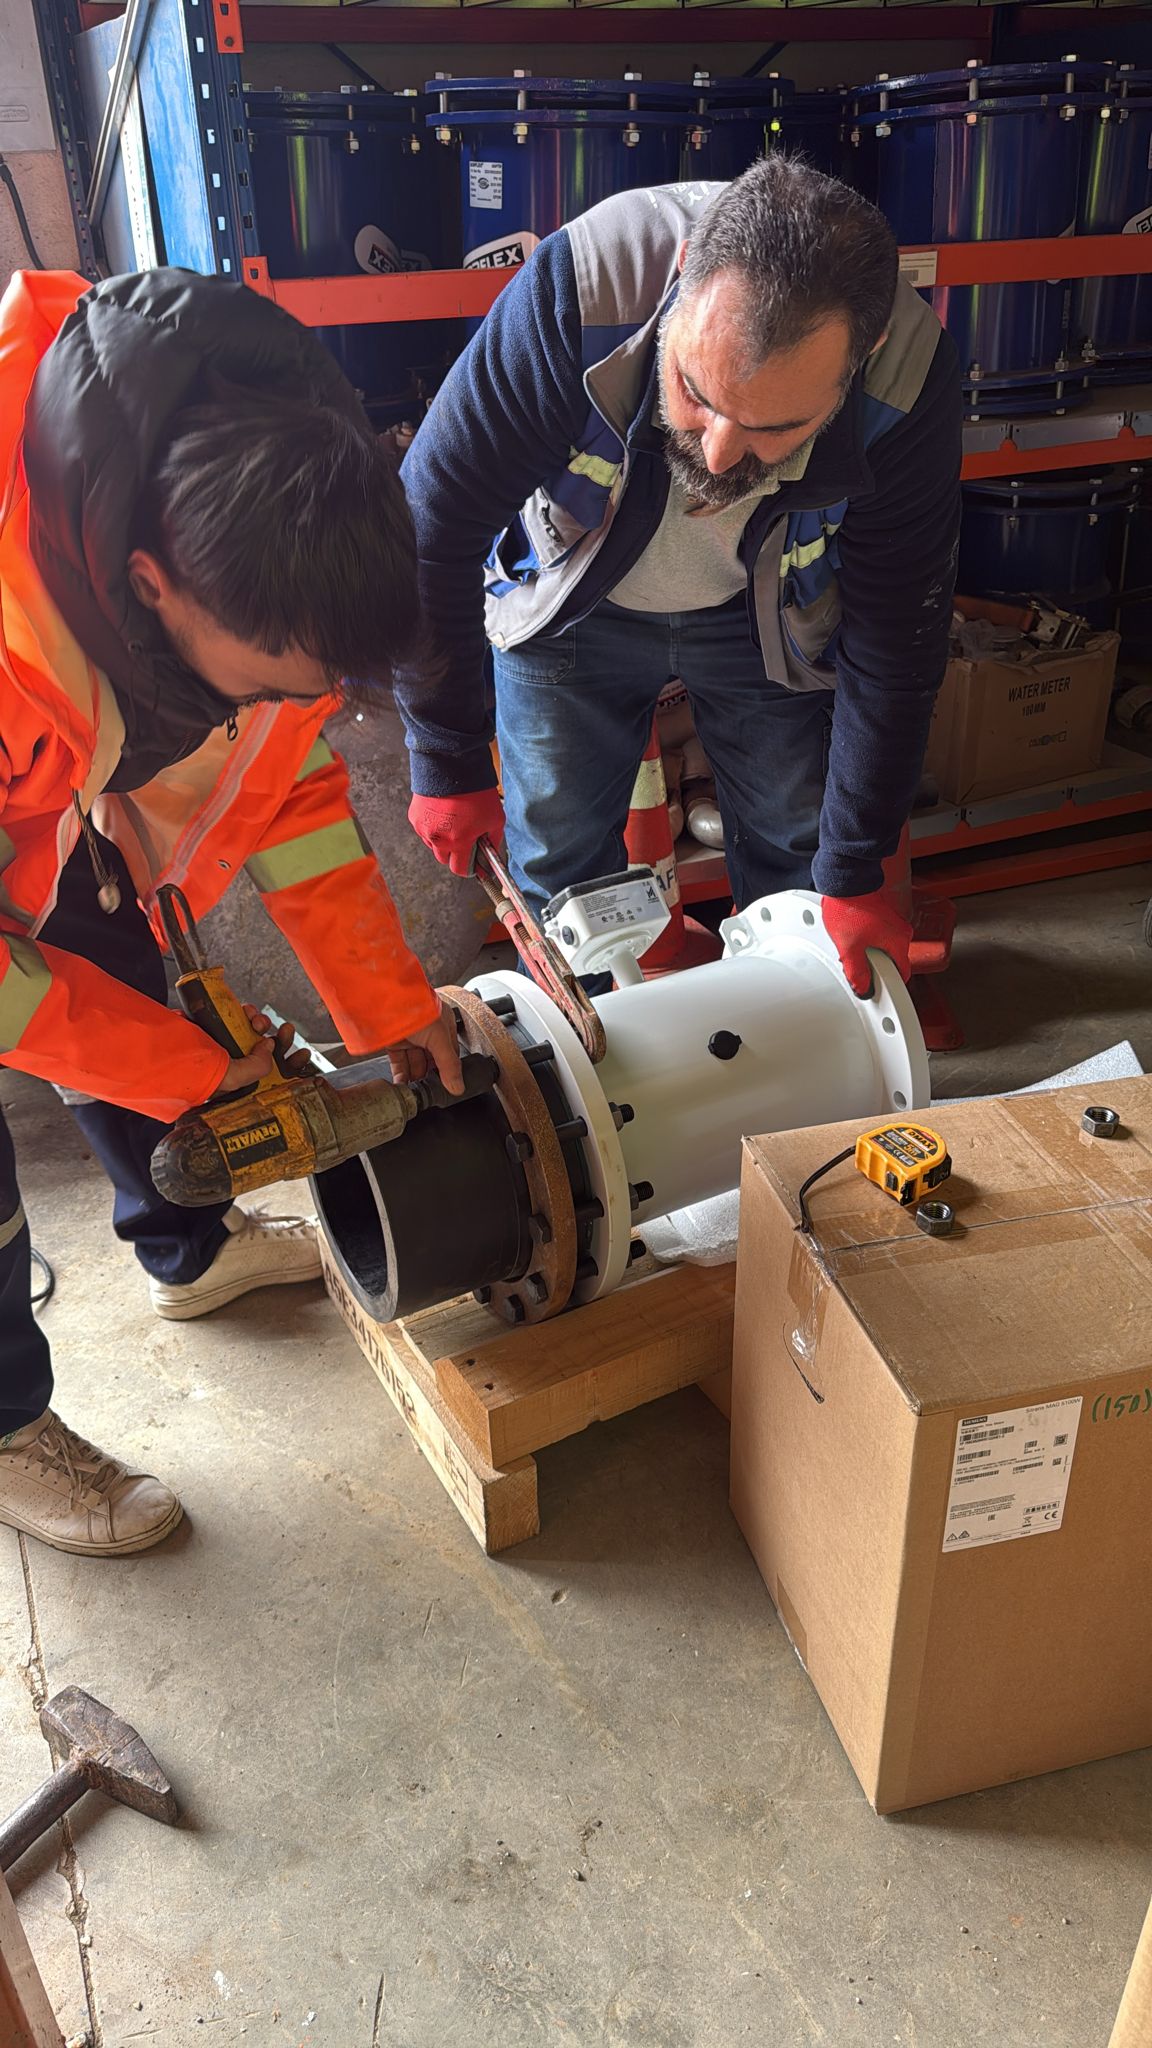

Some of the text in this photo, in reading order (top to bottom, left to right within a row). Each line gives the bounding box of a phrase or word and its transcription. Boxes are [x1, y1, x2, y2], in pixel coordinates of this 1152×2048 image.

[1009, 676, 1070, 702] WATER METER
[908, 1131, 934, 1149] DMAX
[1092, 1388, 1152, 1424] (150)
